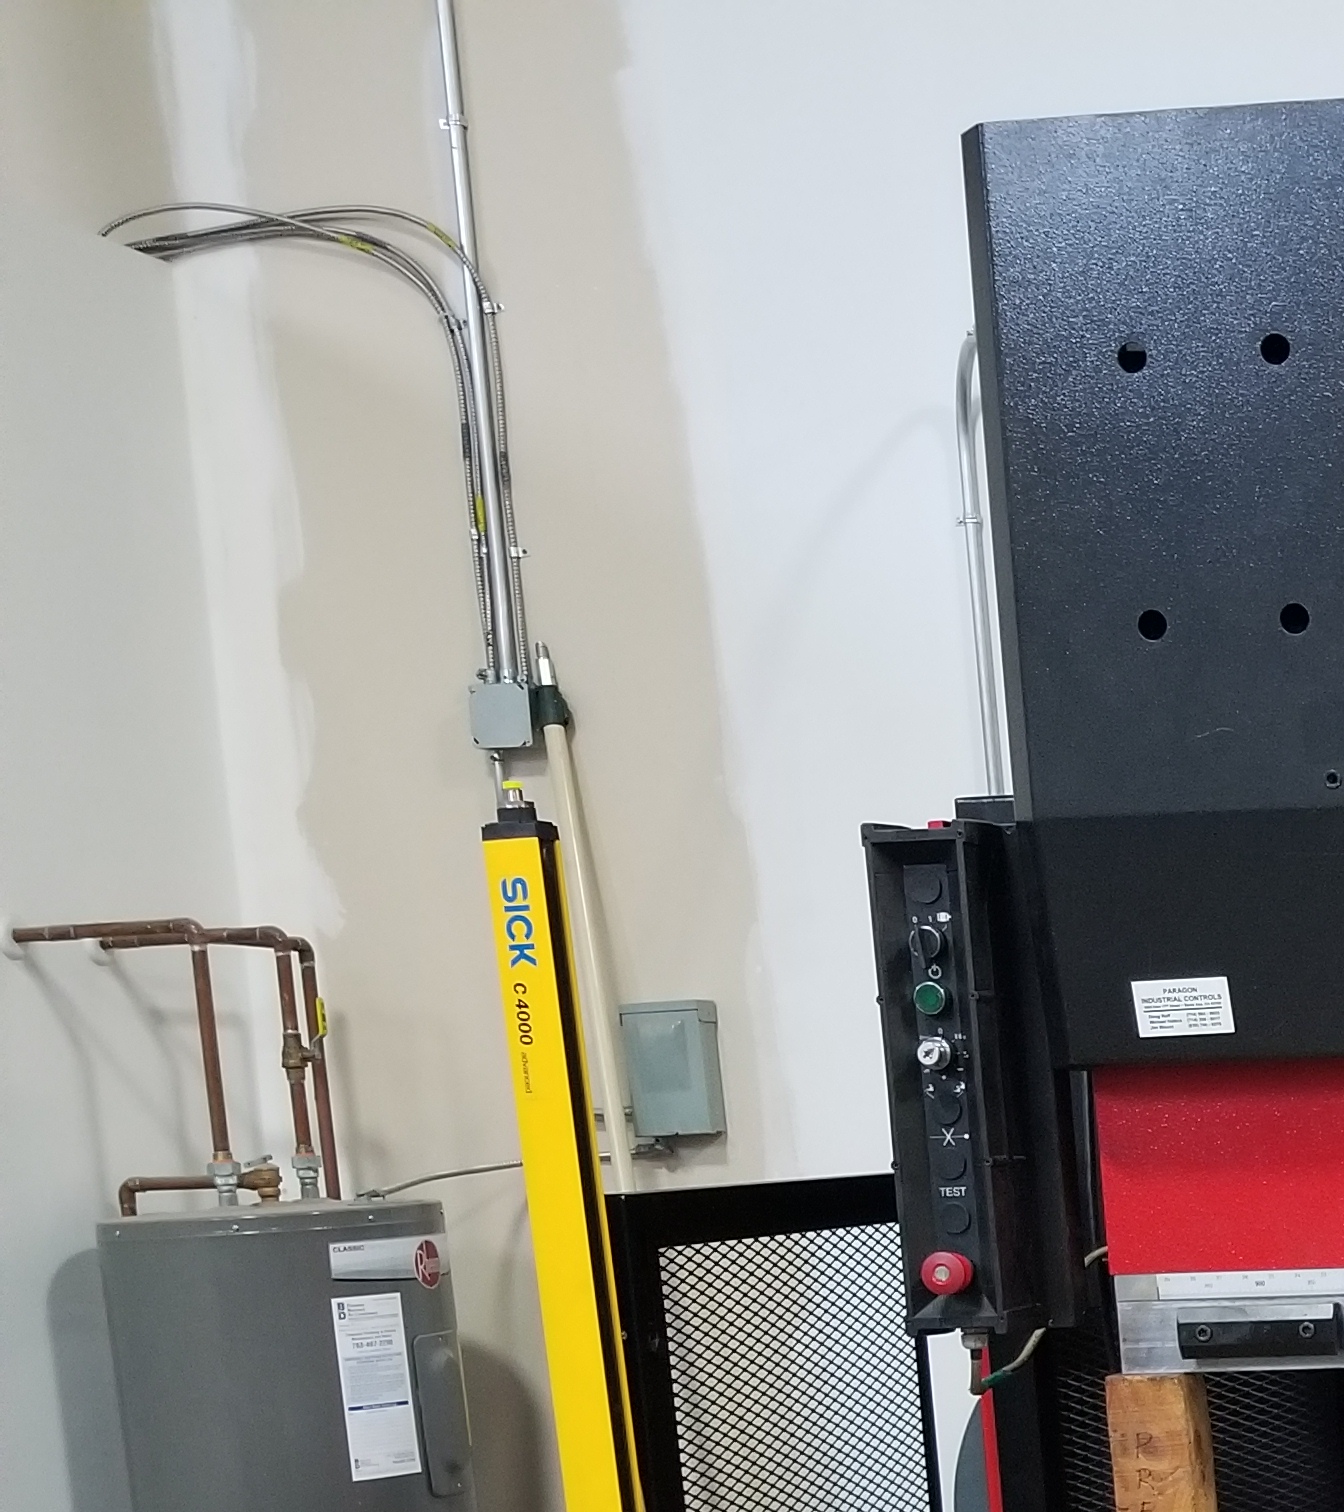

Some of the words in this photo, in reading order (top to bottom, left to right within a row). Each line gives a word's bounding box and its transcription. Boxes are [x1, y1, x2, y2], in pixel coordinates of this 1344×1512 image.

[501, 877, 537, 968] SICK
[1141, 996, 1182, 1004] INDUSTRIAL
[1184, 993, 1222, 1002] CONTROLS
[521, 1051, 533, 1094] advanced
[939, 1187, 967, 1197] TEST
